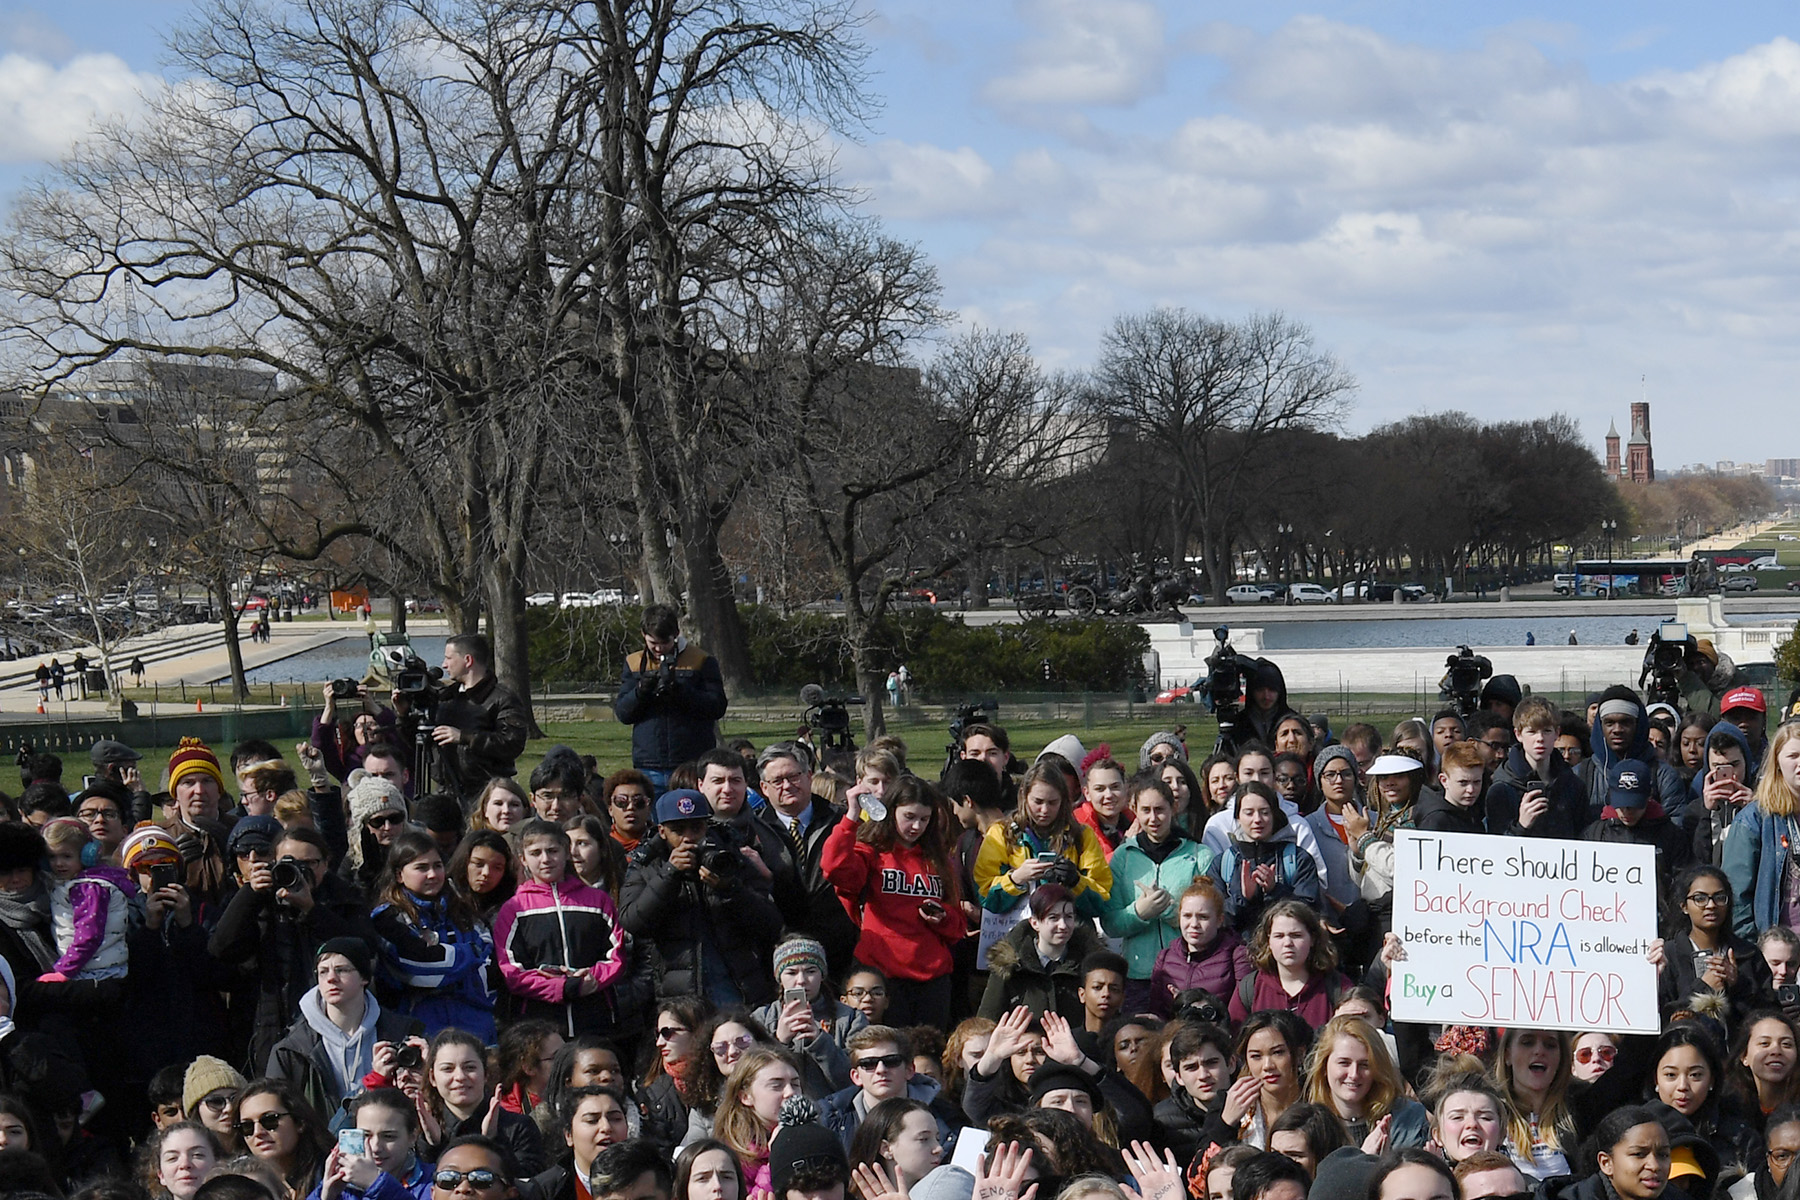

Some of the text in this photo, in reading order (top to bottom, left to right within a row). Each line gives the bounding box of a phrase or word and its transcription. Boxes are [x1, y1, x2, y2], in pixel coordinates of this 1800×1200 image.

[1408, 838, 1643, 885] There should be a
[1414, 880, 1628, 928] Background Check
[1405, 919, 1651, 966] before the NRA is allowed t
[1404, 965, 1631, 1026] Buy a SENATOR
